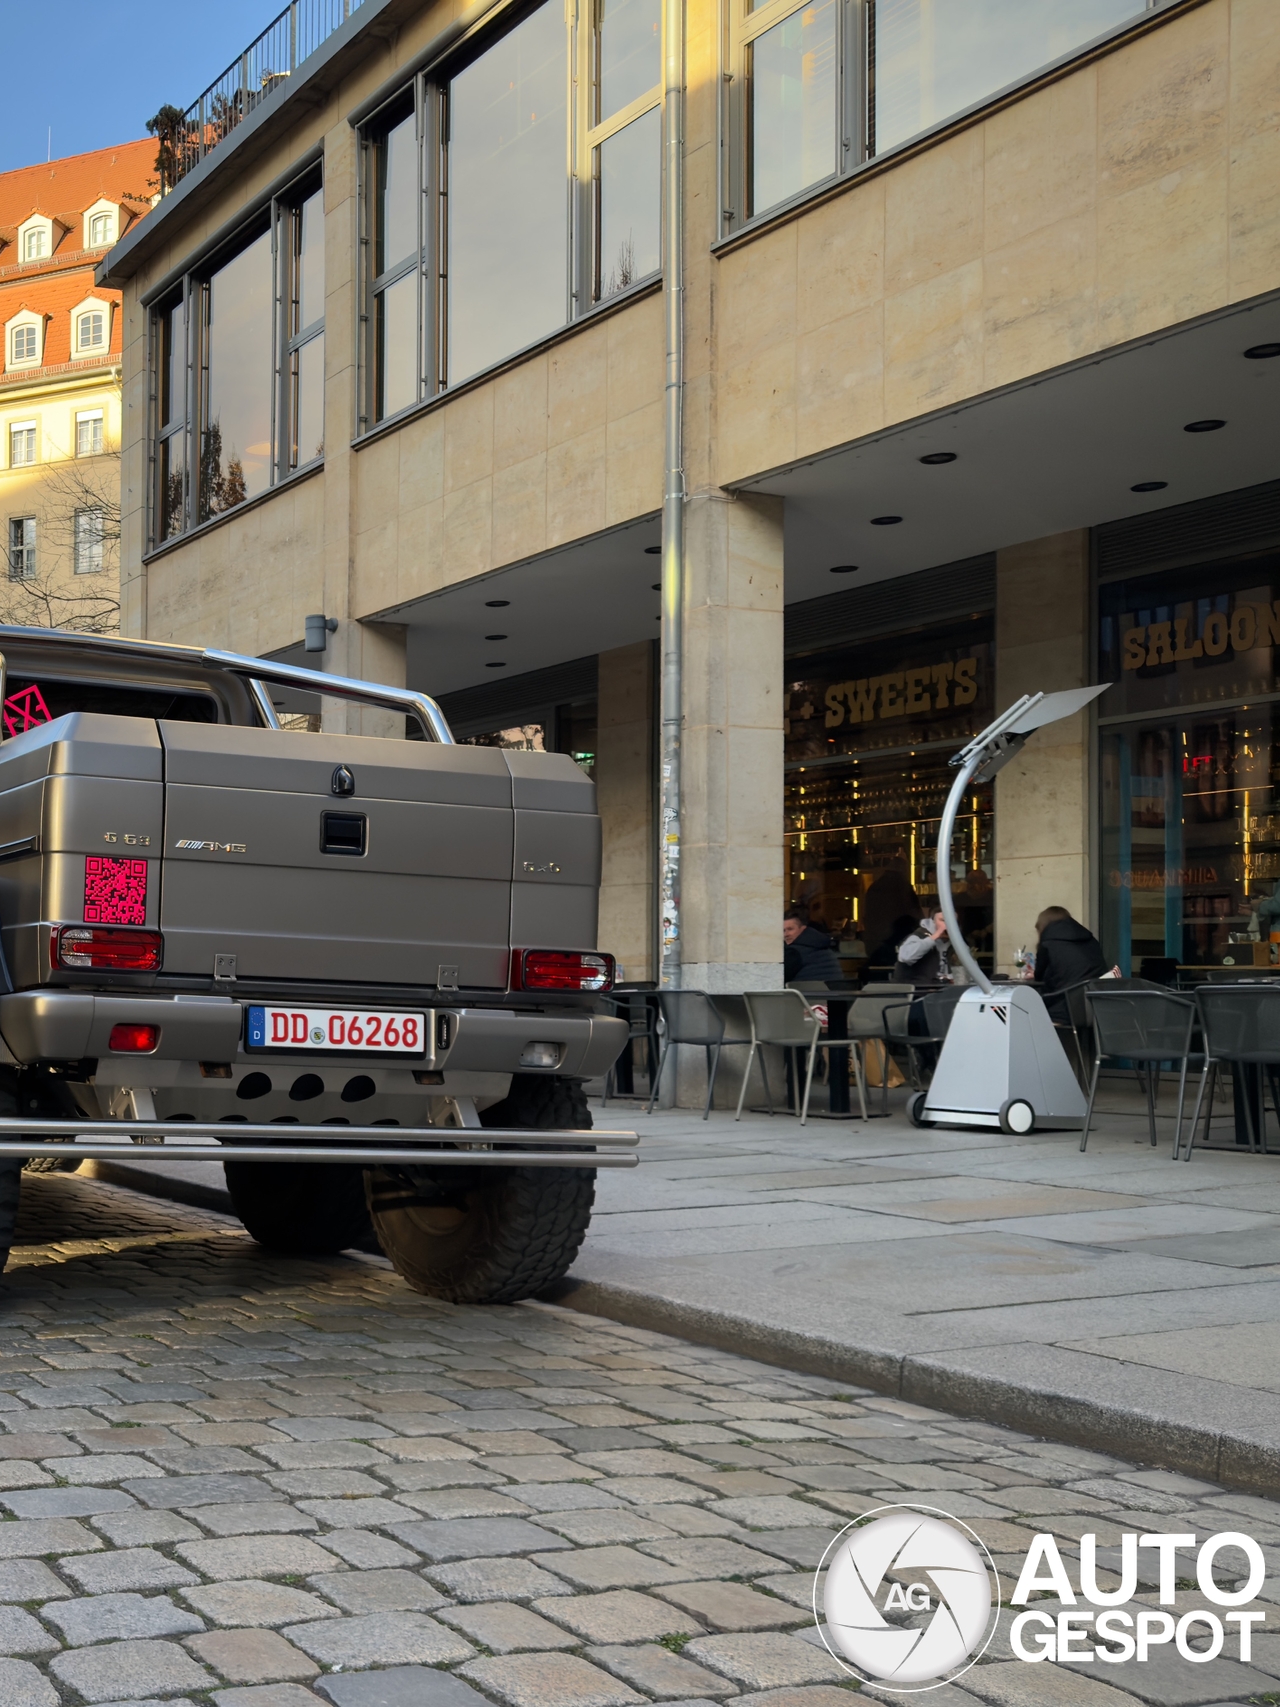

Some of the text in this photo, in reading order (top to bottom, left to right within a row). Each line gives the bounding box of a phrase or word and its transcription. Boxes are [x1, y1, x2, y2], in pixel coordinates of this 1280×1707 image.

[1123, 601, 1280, 670] SALOON
[825, 657, 977, 728] SWEETS
[104, 832, 151, 846] G 63
[200, 841, 246, 853] AMG
[253, 1013, 418, 1048] D DD 06268
